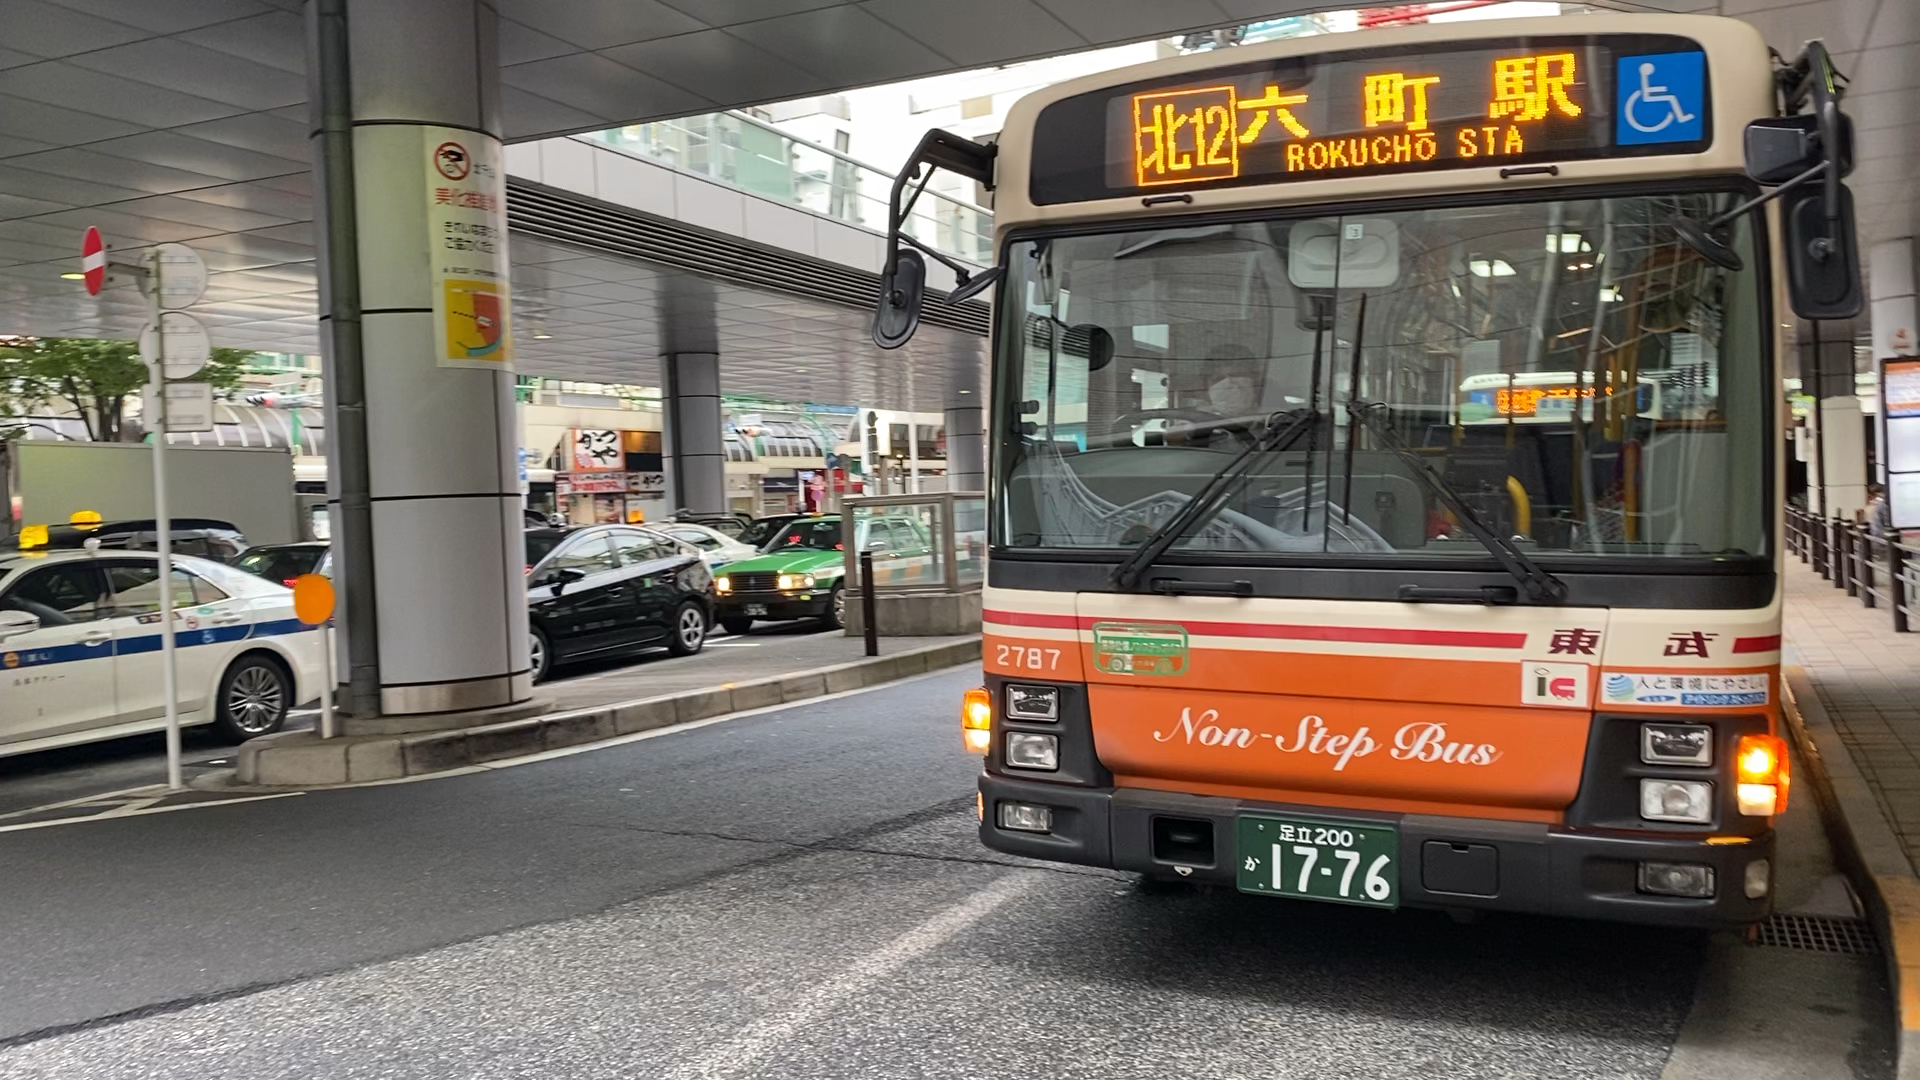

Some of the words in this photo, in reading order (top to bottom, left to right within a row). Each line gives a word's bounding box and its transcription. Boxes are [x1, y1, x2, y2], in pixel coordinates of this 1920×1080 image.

[1458, 124, 1525, 158] STA
[996, 644, 1061, 671] 2787
[1547, 628, 1720, 658] 東武
[1153, 706, 1384, 772] Non-Step
[1390, 721, 1504, 766] Bus
[1243, 855, 1261, 872] か
[1271, 843, 1391, 901] 17-76
